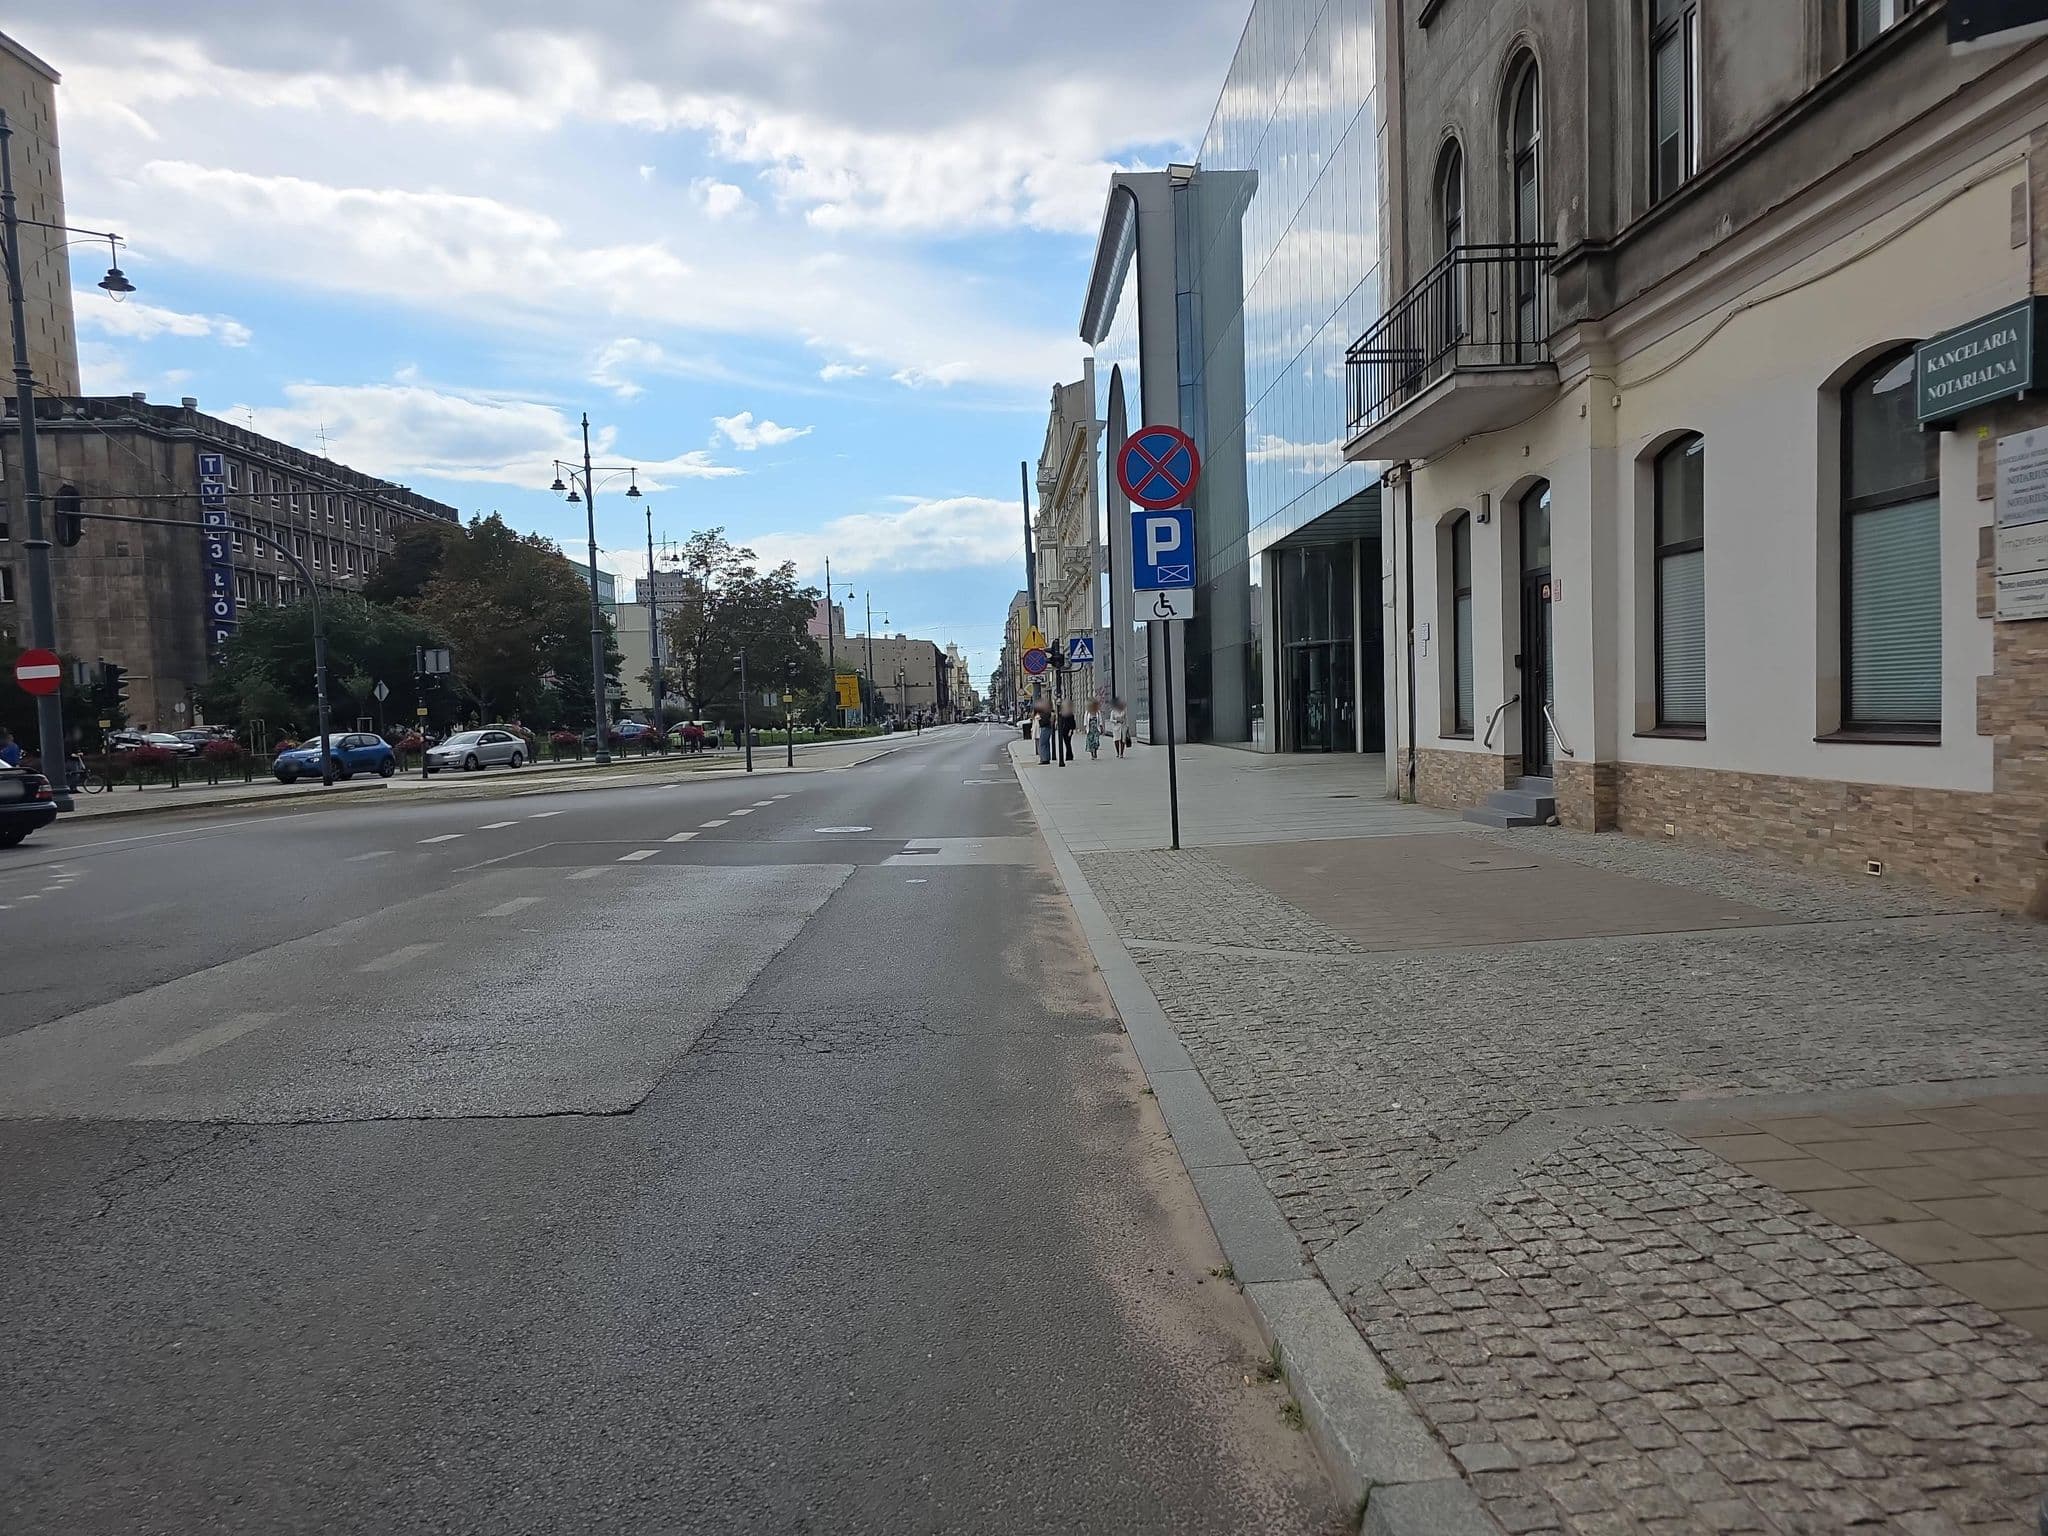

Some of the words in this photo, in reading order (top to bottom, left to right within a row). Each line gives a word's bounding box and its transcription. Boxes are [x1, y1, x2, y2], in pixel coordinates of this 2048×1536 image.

[1927, 327, 2018, 373] KANCELARIA
[1927, 358, 2017, 401] NOTARIALNA
[1145, 516, 1181, 566] P
[213, 572, 230, 668] ŁÓD
